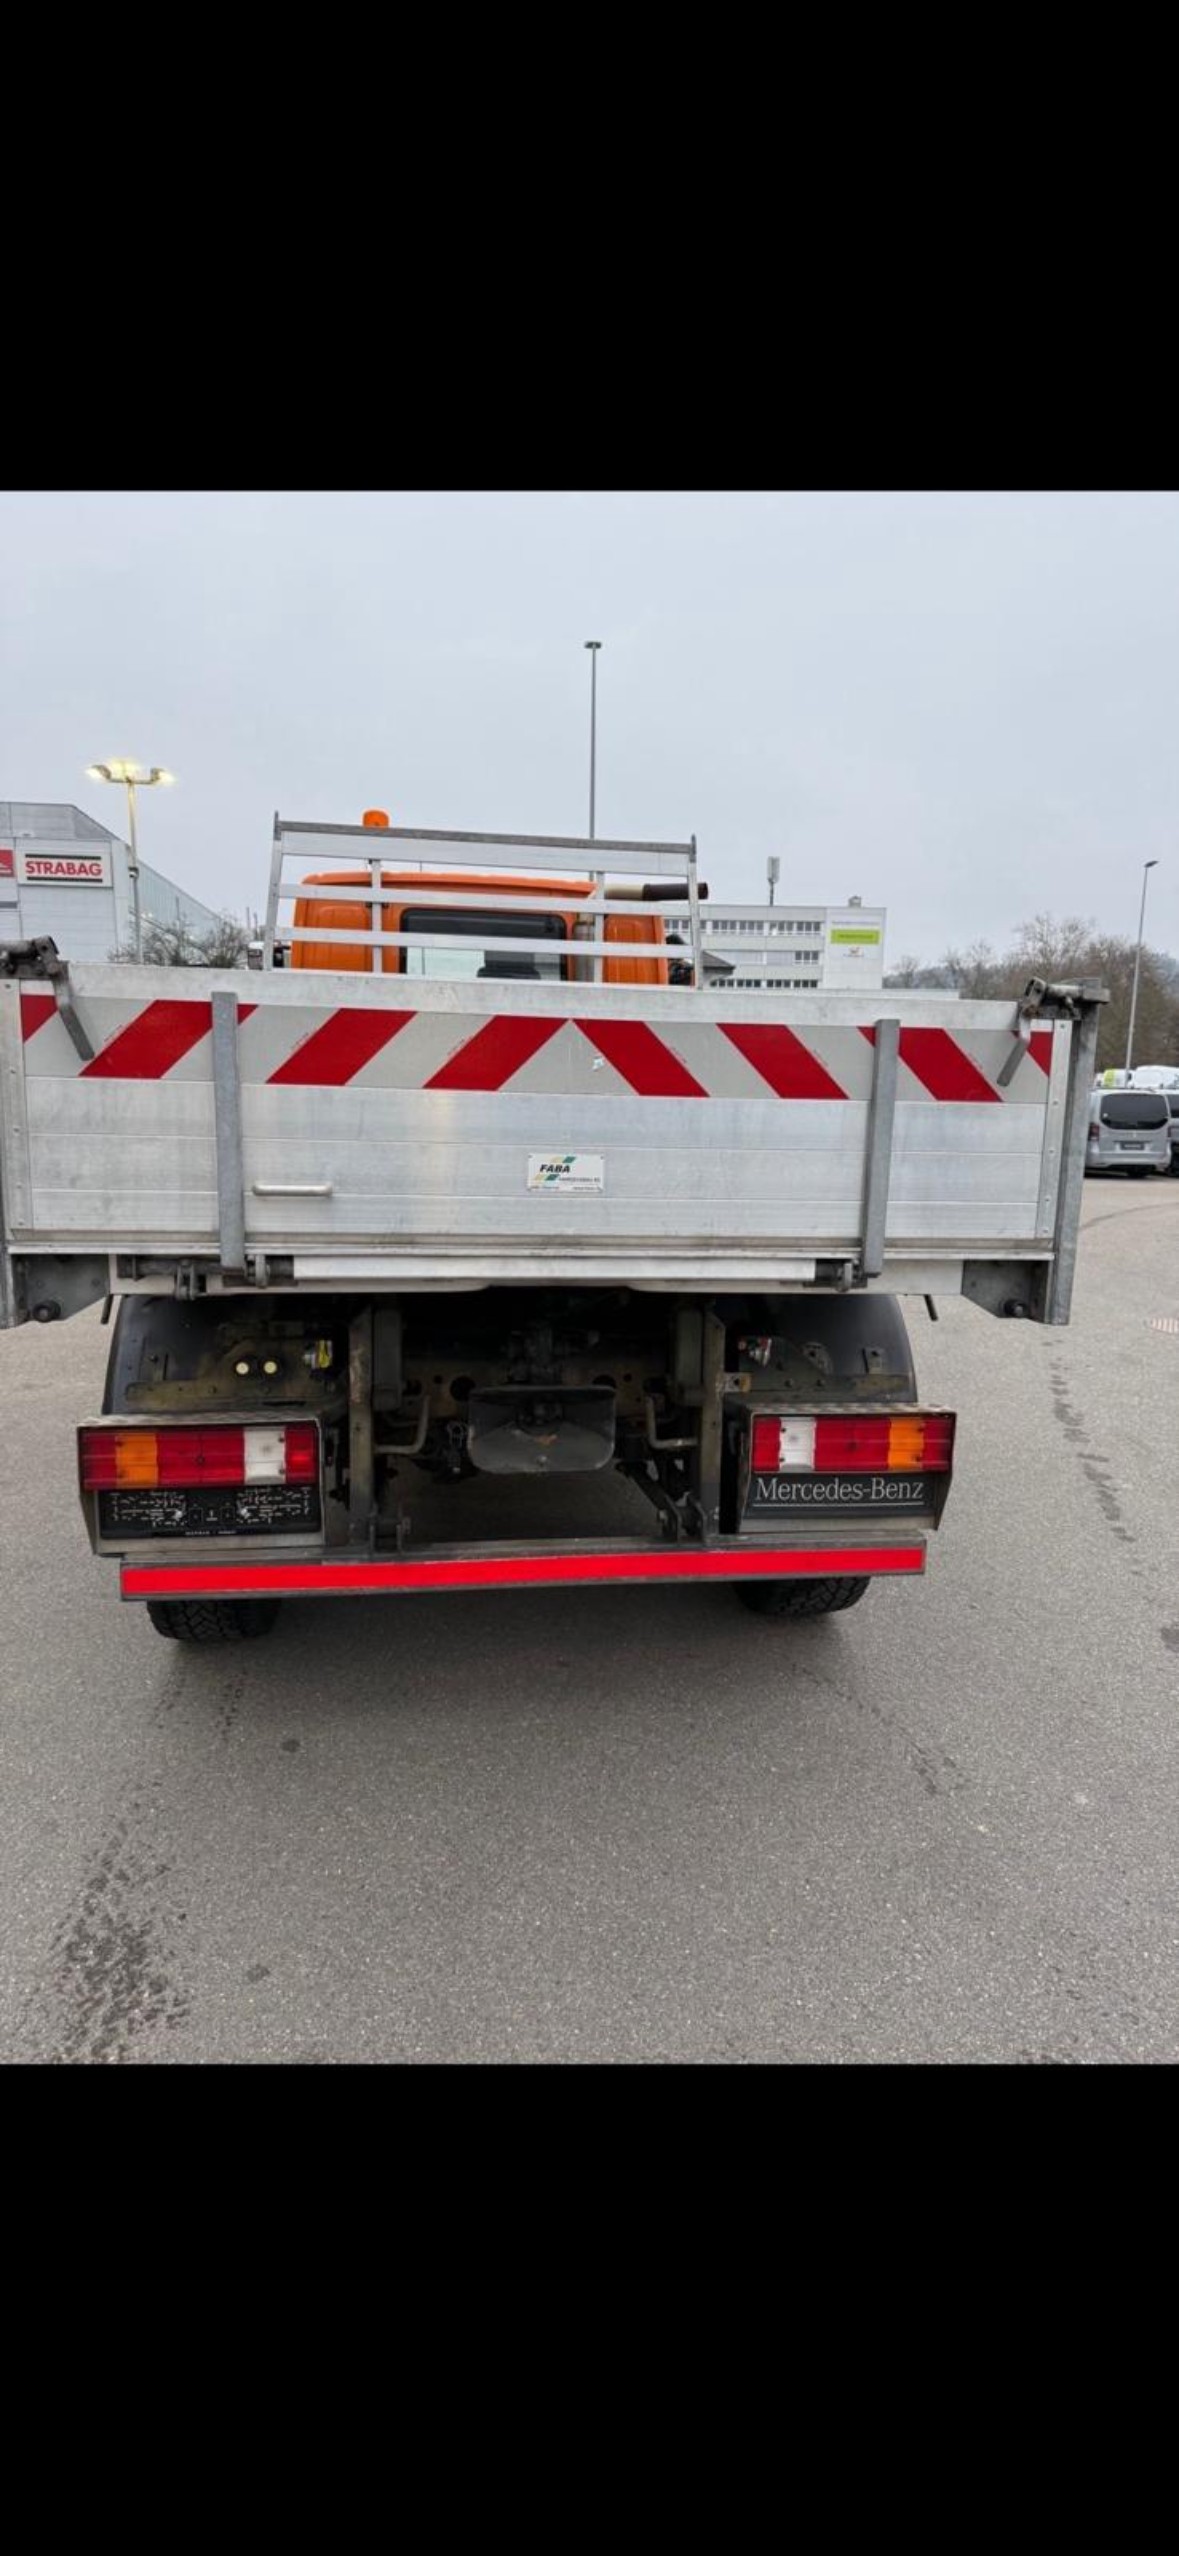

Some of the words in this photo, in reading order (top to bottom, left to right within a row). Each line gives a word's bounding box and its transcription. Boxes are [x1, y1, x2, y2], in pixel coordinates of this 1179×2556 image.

[25, 860, 102, 876] STRABAG
[539, 1164, 570, 1173] FABA
[755, 1477, 924, 1501] Mercedes-Benz
